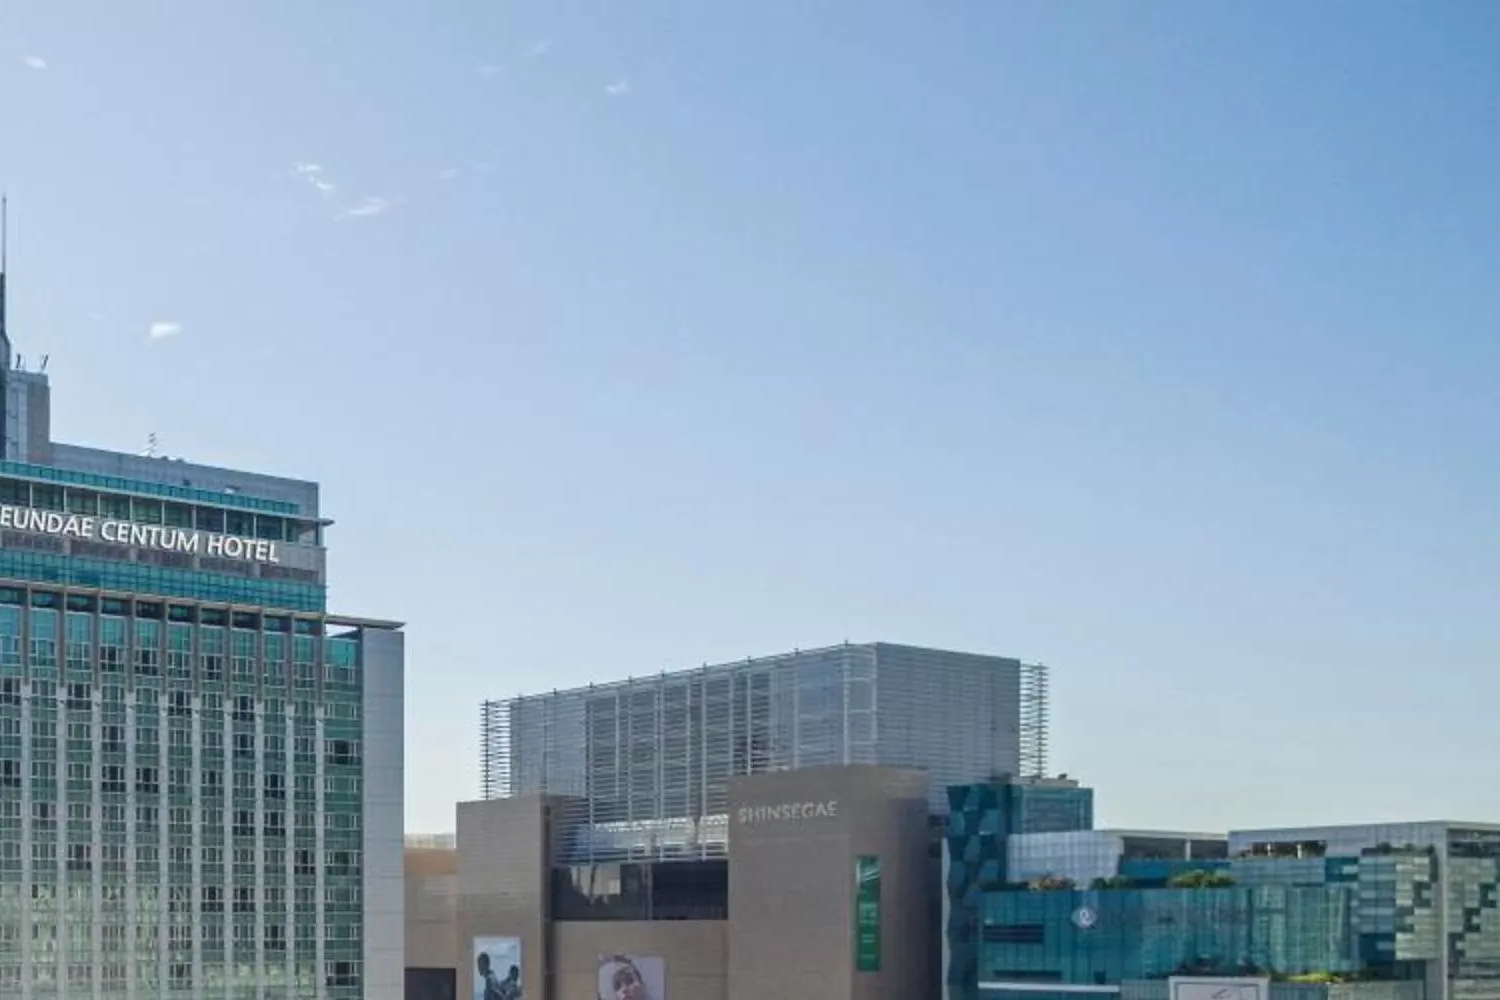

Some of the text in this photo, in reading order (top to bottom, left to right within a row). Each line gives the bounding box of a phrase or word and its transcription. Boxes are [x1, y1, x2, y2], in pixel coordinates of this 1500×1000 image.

[100, 519, 200, 552] CENTUM
[206, 534, 280, 563] HOTEL
[738, 800, 838, 824] SHINSEGAE
